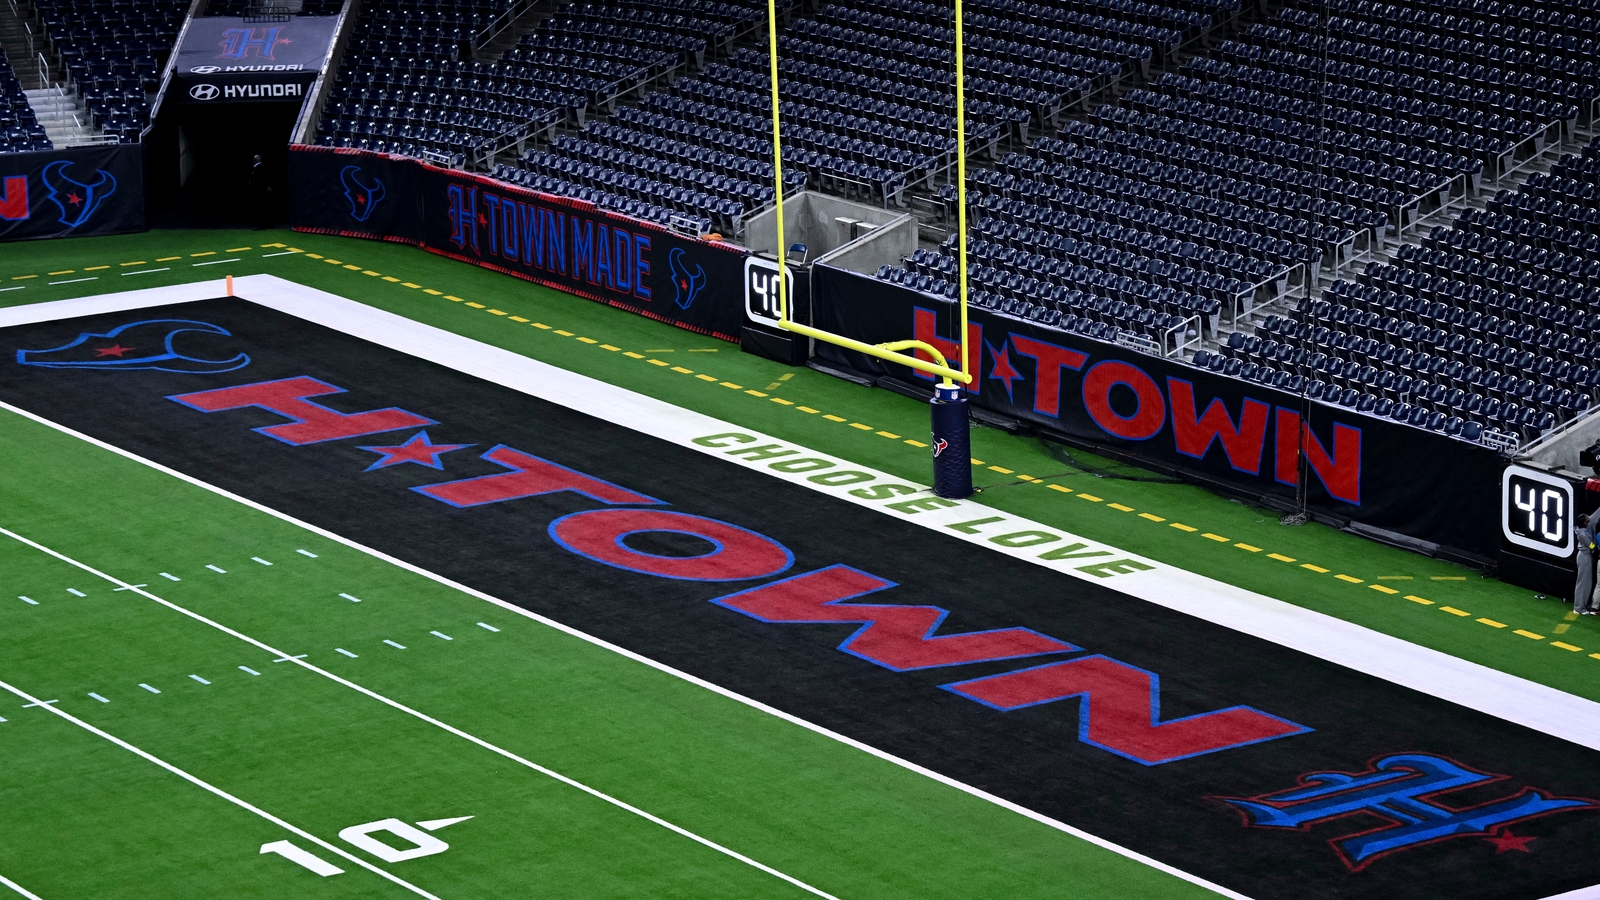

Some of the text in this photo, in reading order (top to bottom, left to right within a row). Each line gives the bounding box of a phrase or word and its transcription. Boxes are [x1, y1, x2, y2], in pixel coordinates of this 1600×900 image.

[224, 83, 302, 98] HYUNDAI
[225, 64, 304, 72] HYUNDAI
[571, 215, 652, 302] MADE
[753, 271, 786, 318] 40
[691, 432, 1156, 579] CHOOSE LOVE
[1514, 483, 1563, 542] 40
[259, 817, 450, 878] 10
